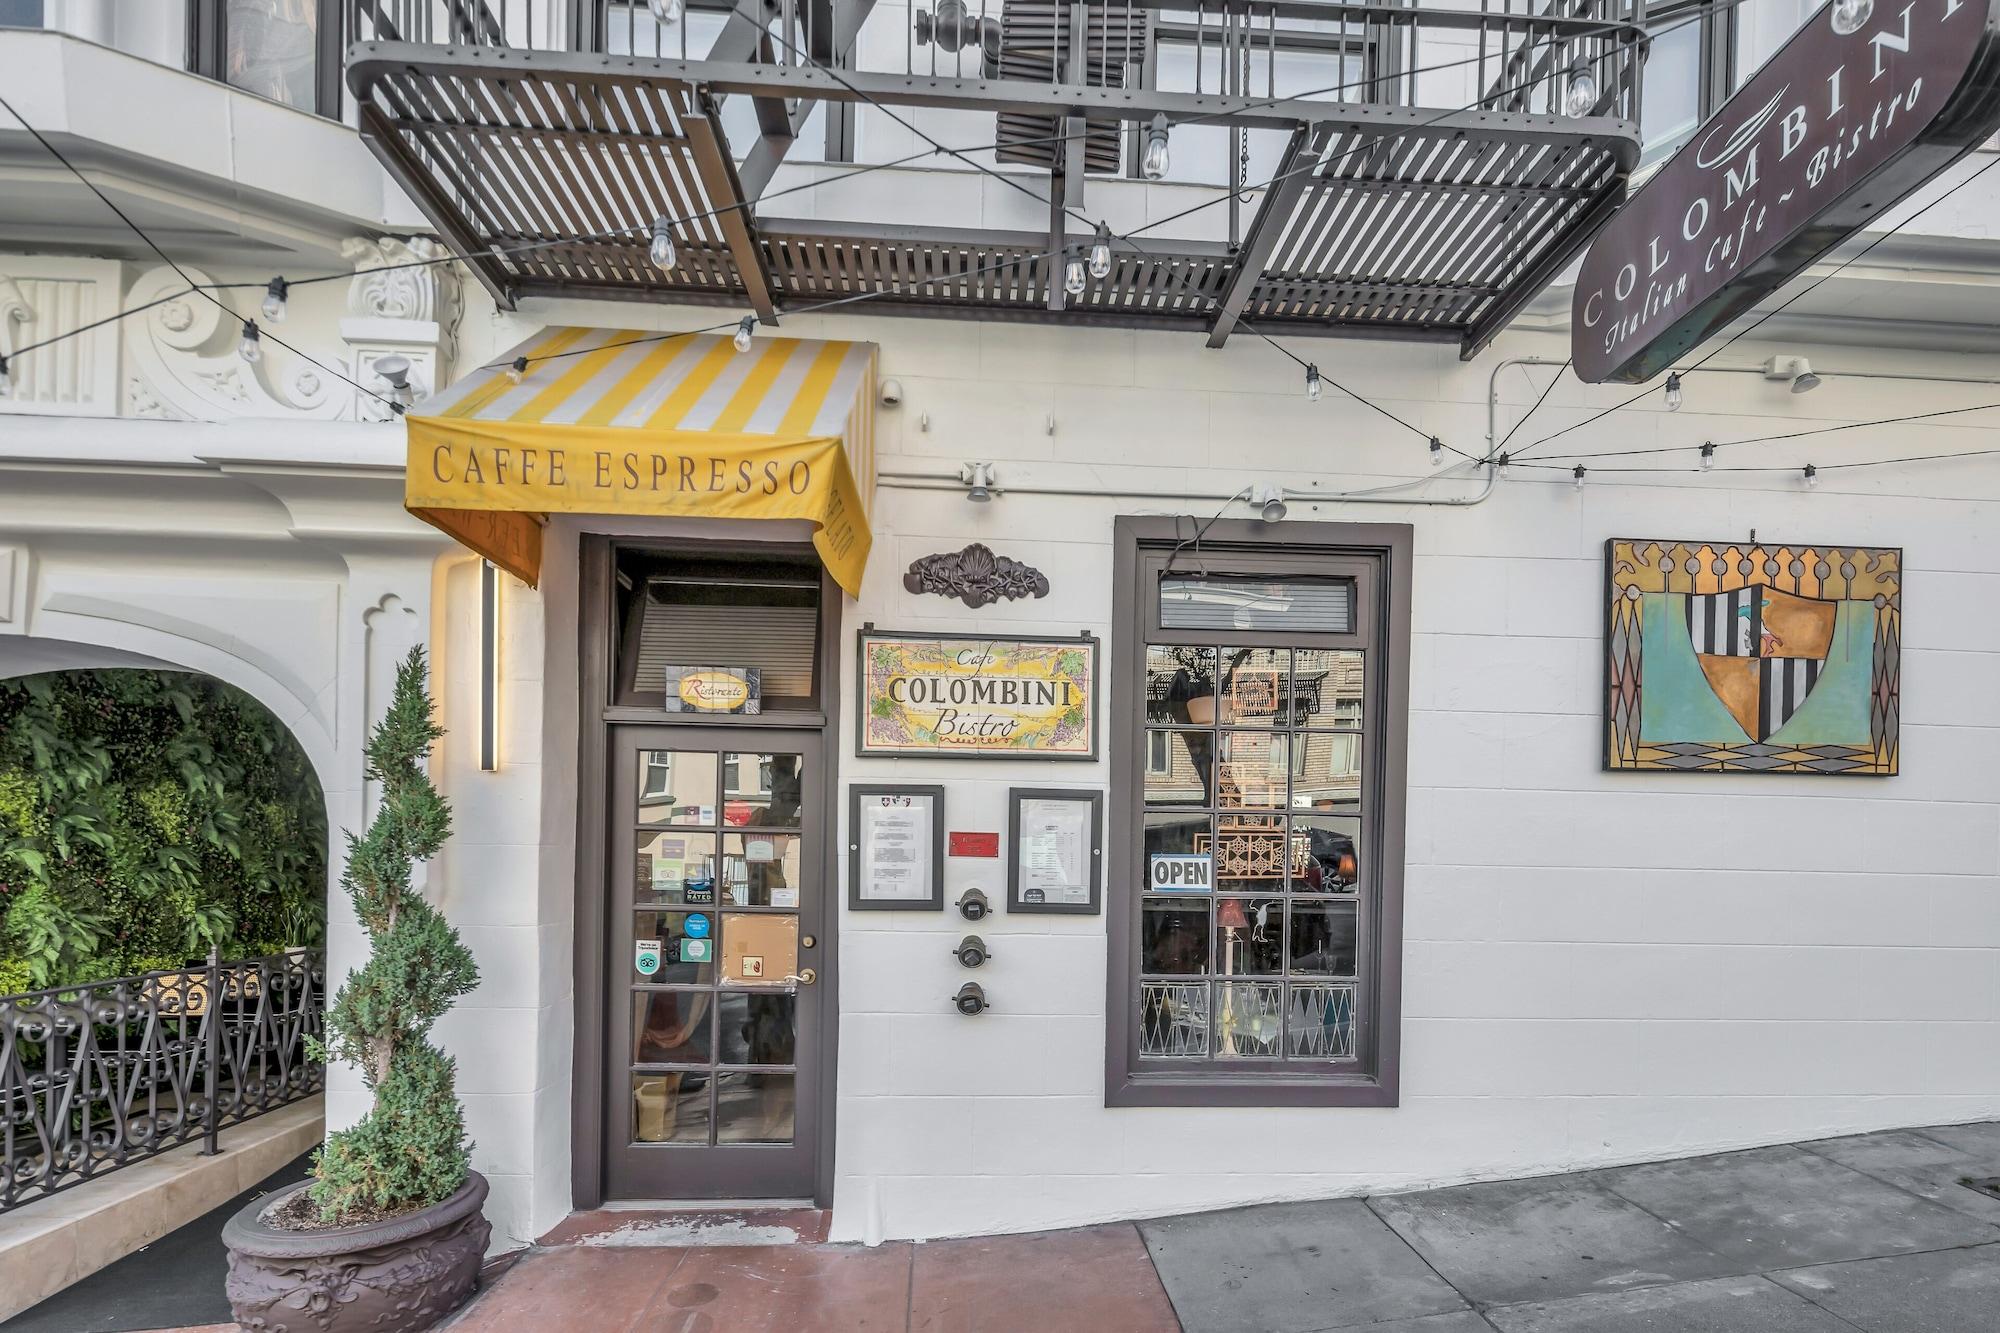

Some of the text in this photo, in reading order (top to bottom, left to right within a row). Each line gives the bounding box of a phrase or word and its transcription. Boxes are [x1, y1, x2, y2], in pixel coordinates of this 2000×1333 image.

[1583, 0, 1964, 328] COLOMBIN
[1604, 272, 1688, 354] Italian
[1704, 198, 1767, 273] Cafe
[1806, 77, 1922, 189] Bistro
[432, 444, 812, 496] CAFFE ESPRESSO
[957, 640, 999, 680] Cafe
[686, 678, 742, 701] Ristorante
[888, 677, 1072, 706] COLOMBINI
[933, 707, 1021, 737] Bistro
[1154, 861, 1209, 885] OPEN
